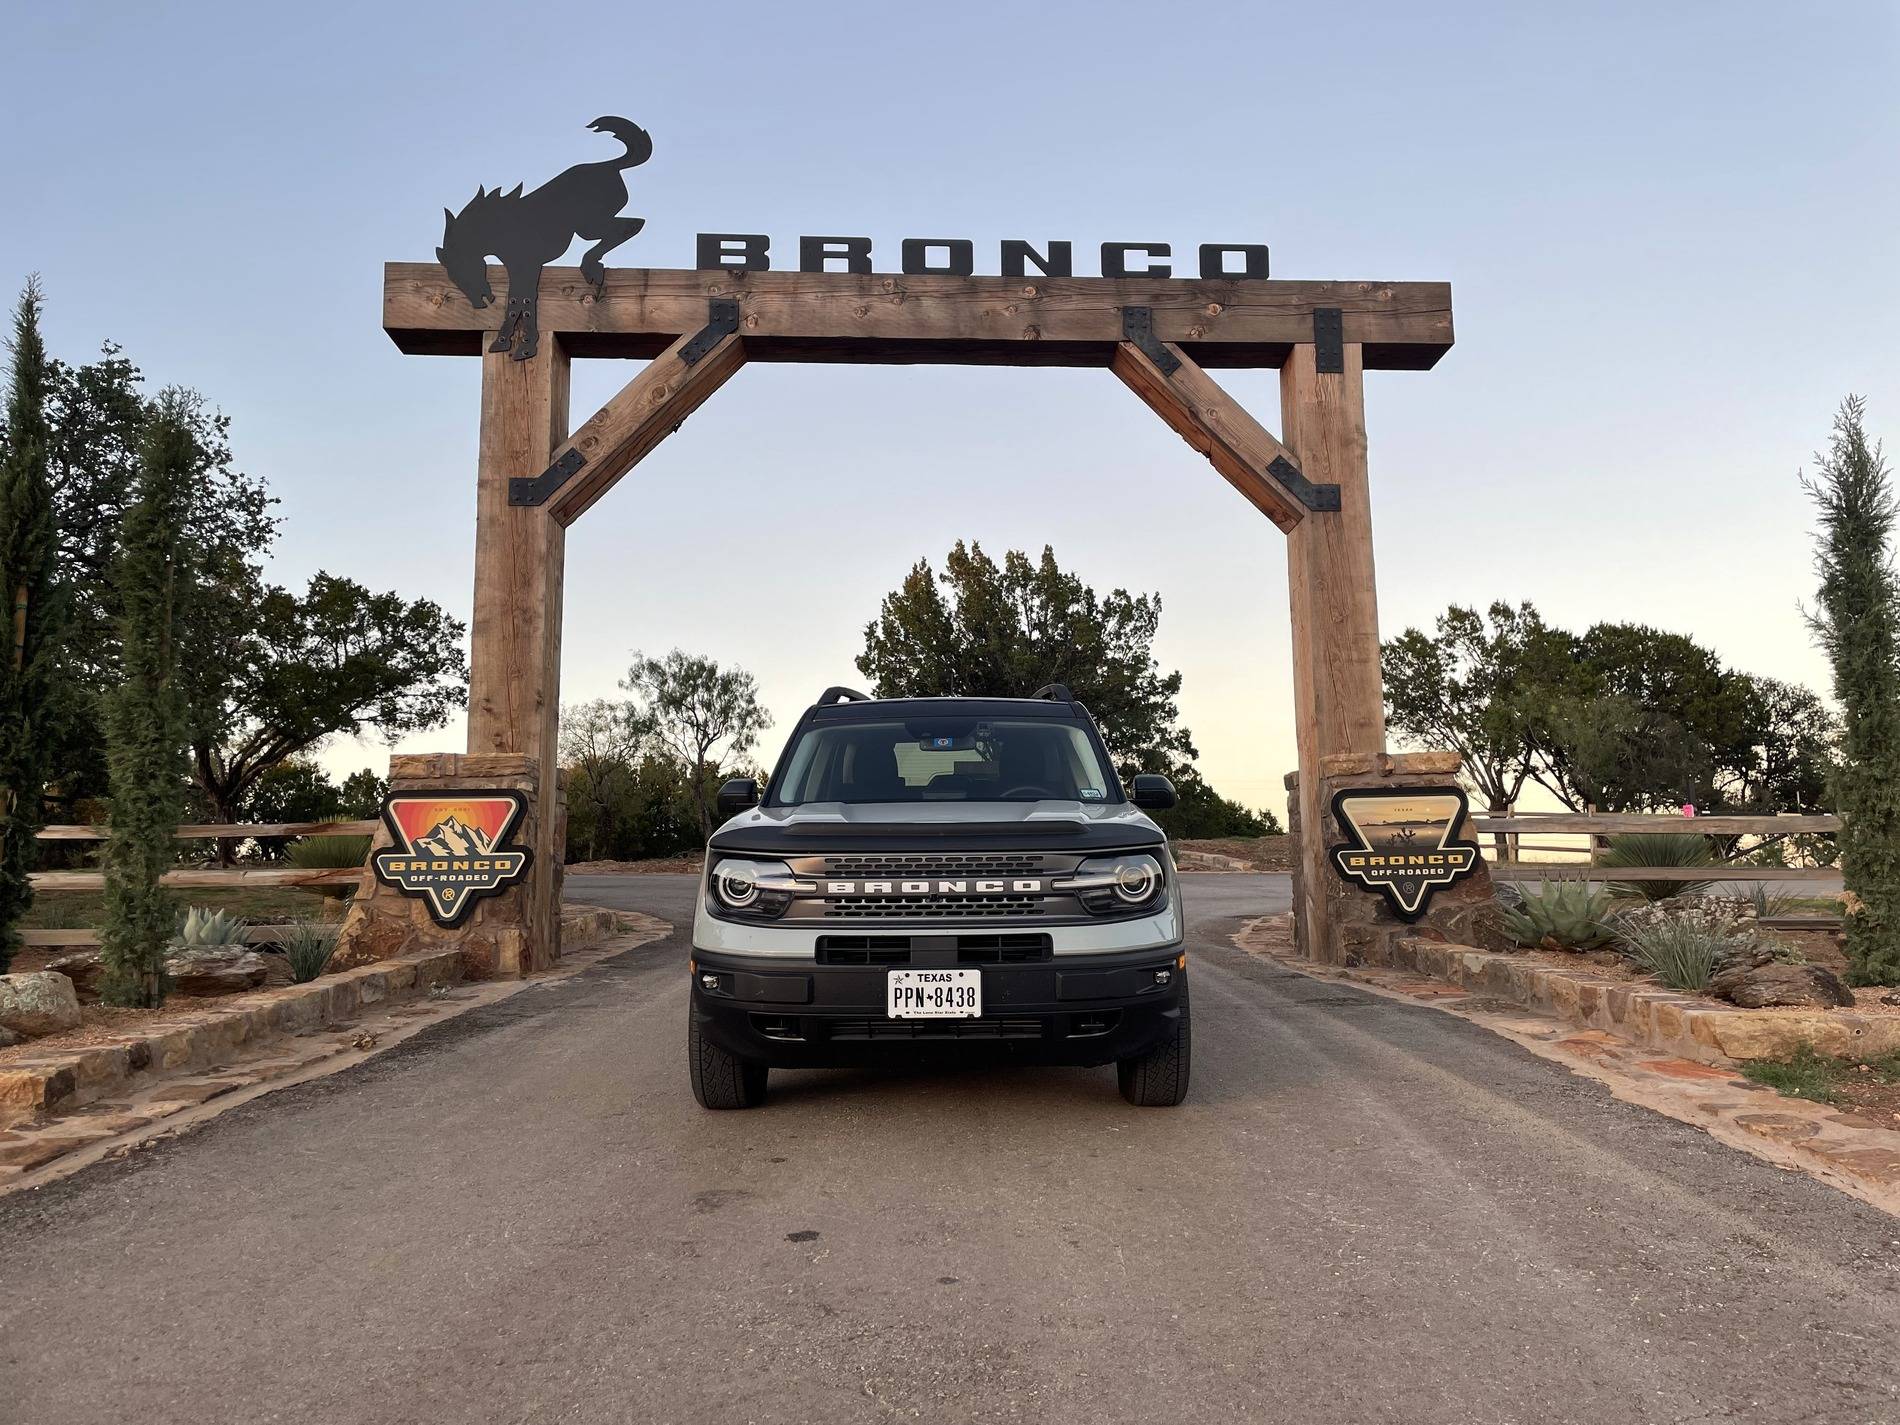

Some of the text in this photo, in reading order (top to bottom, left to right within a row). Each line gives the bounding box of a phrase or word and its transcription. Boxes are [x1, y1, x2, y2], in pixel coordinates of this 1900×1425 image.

[697, 233, 1269, 280] BRONCO
[389, 860, 511, 871] BRONCO
[1350, 855, 1463, 866] BRONCO
[1371, 868, 1445, 876] OFF-ROADEO
[410, 874, 489, 882] OFF-ROADEO
[827, 880, 1041, 893] BRONCO
[917, 973, 952, 982] TEXAS
